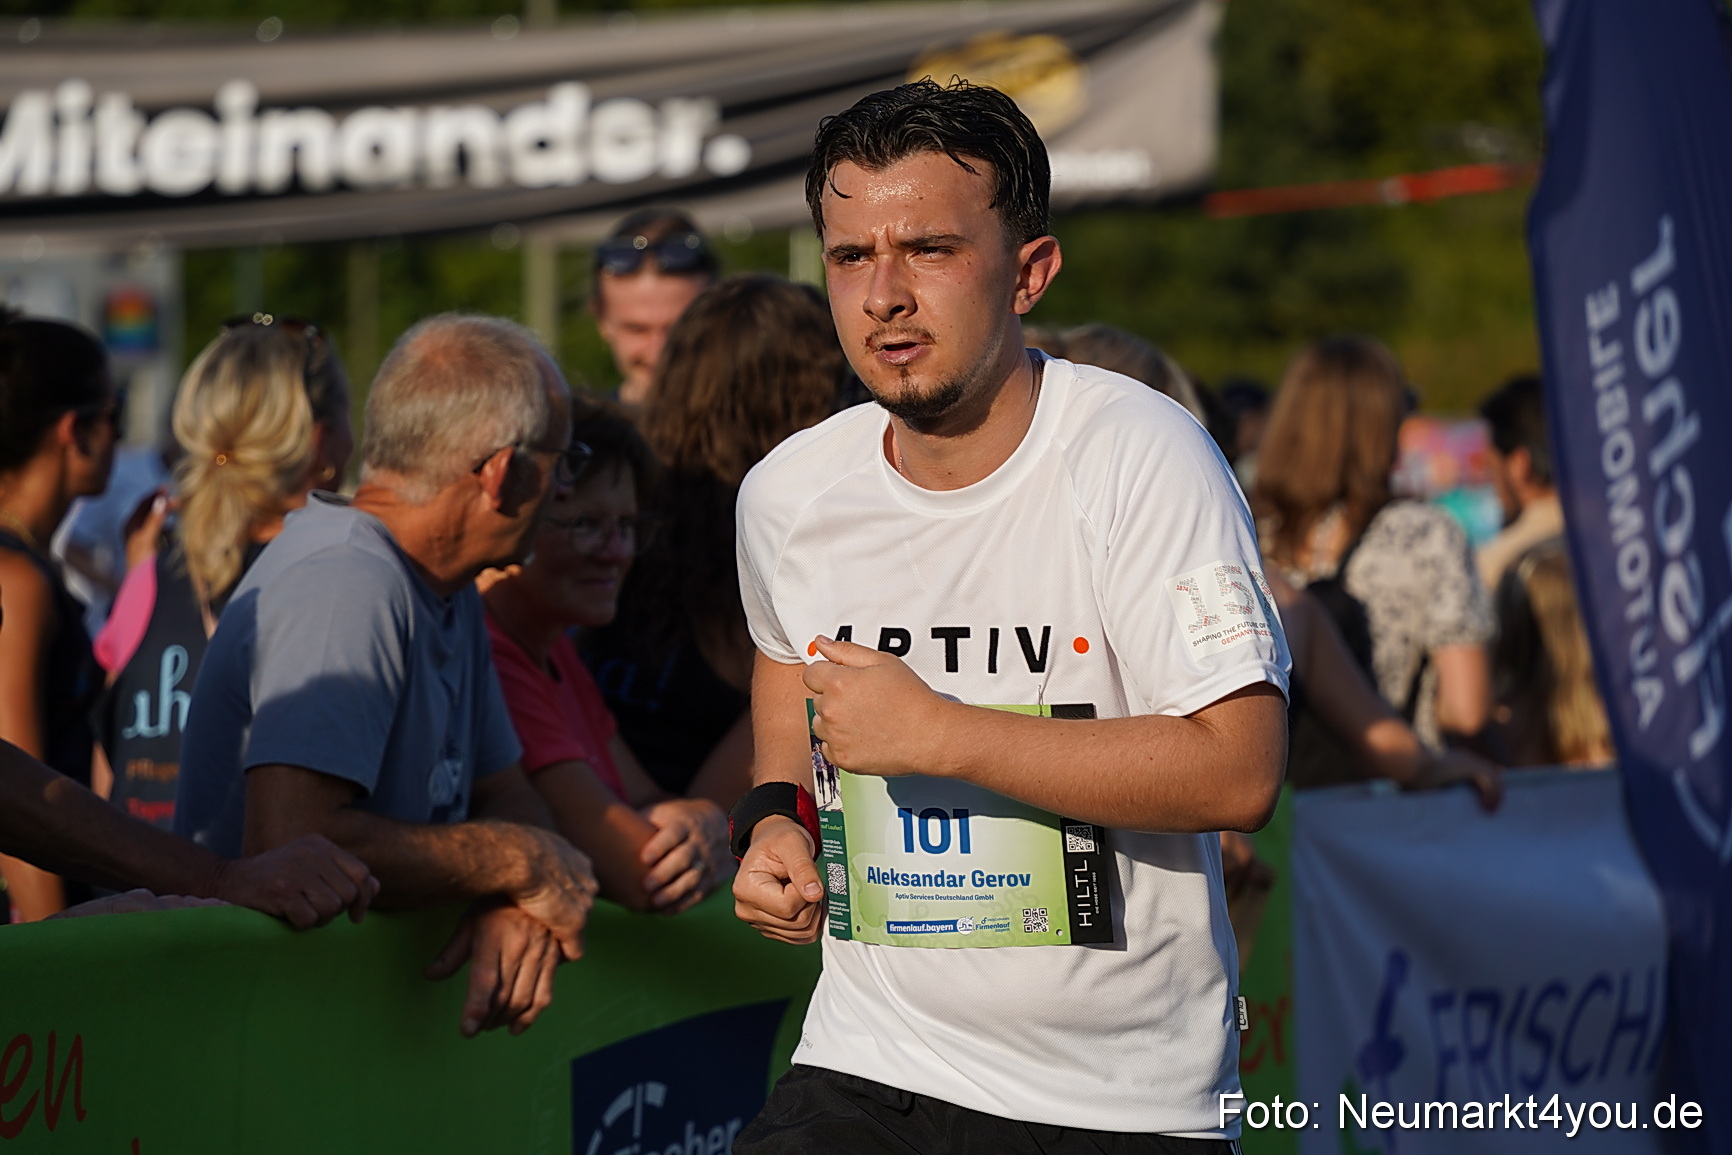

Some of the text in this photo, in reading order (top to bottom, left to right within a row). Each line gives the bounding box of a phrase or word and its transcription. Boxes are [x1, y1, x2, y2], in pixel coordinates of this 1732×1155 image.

[1192, 631, 1222, 647] SHAPING
[1222, 626, 1236, 636] THE
[1221, 629, 1253, 645] GERMANY
[898, 807, 971, 855] 101
[867, 866, 1031, 888] Aleksandar Gerov
[1074, 860, 1092, 926] HILTL
[889, 923, 953, 933] firmenlauf.bayern
[976, 921, 1010, 930] Firmenlauf
